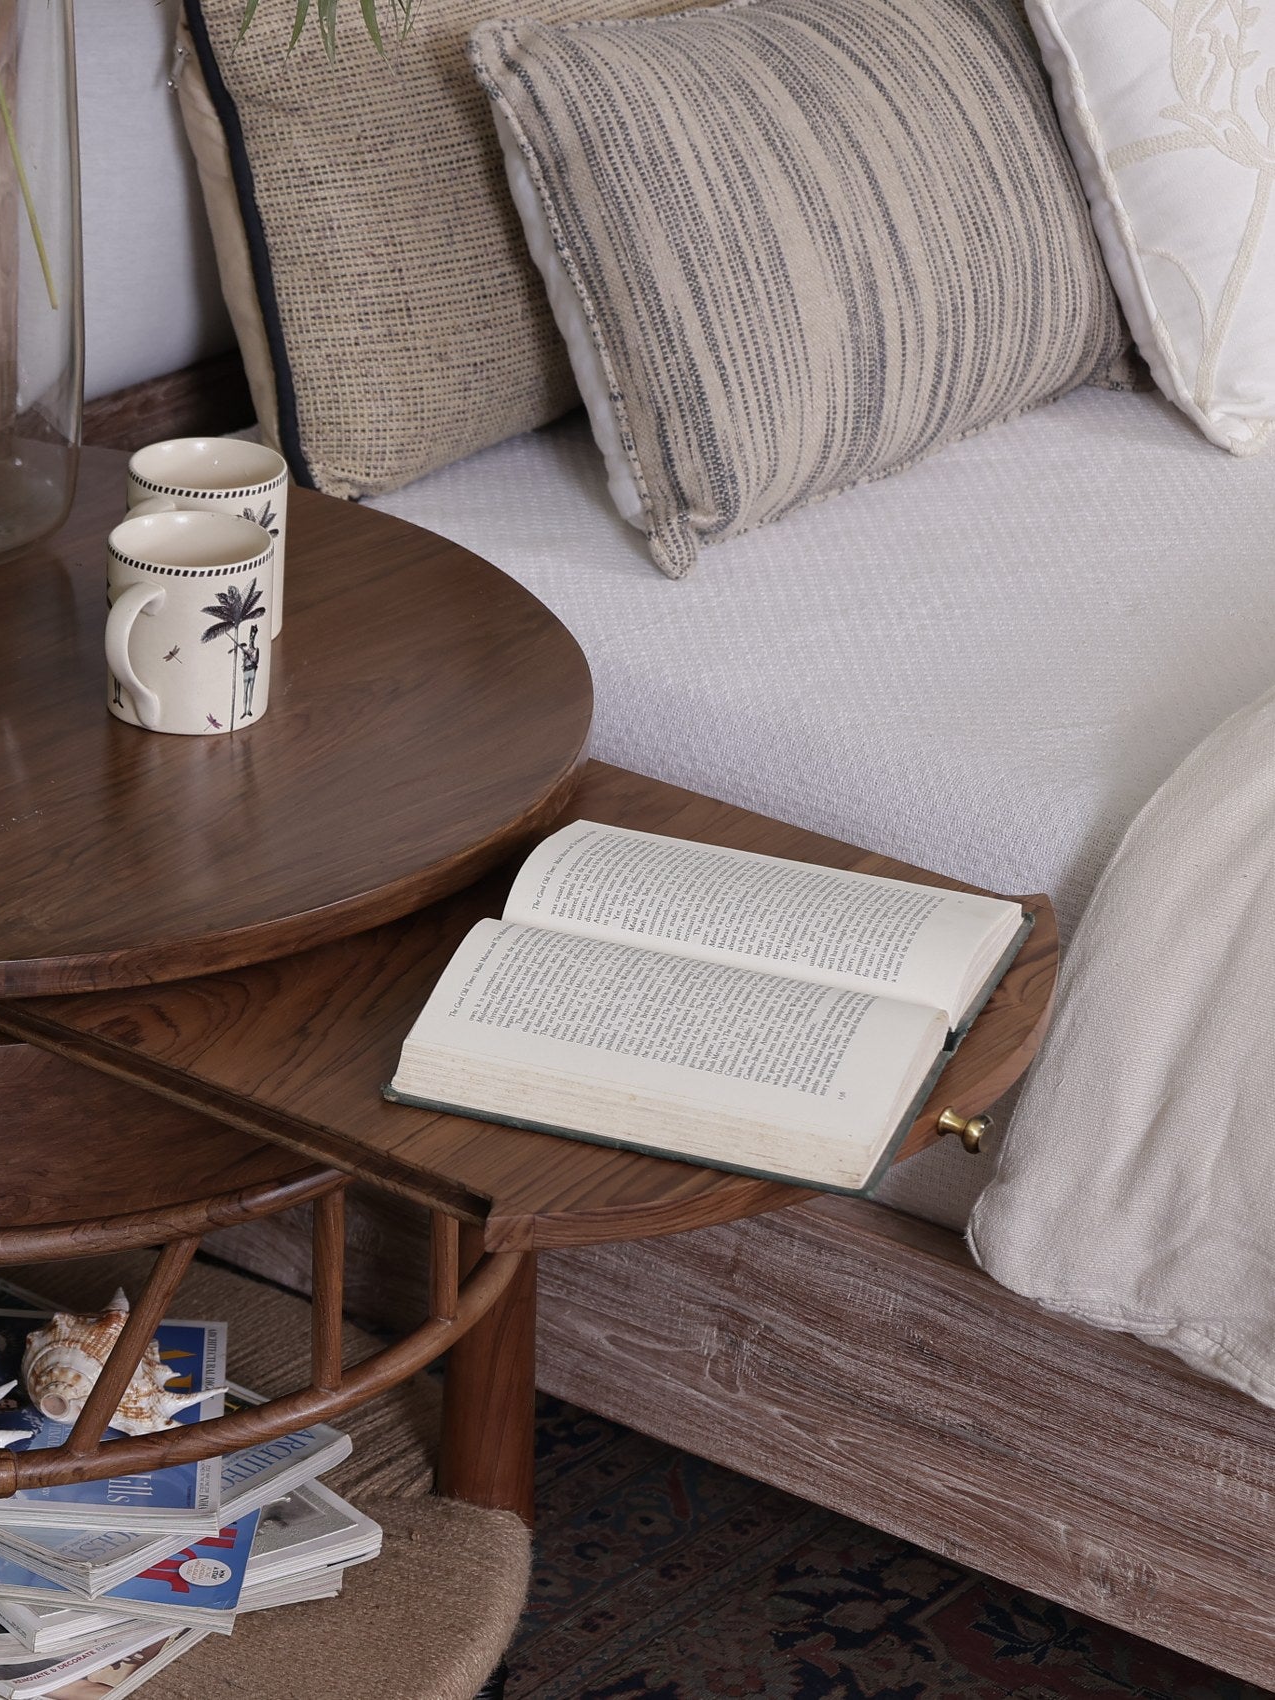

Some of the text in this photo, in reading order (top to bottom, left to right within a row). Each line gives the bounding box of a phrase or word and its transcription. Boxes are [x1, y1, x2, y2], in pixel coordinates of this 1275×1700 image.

[482, 971, 498, 995] nevertheless
[496, 984, 511, 1005] fragments
[515, 988, 539, 1023] Though Peacock
[496, 1014, 505, 1026] could
[502, 1015, 514, 1028] began
[539, 1024, 550, 1035] They
[792, 1066, 805, 1084] Peacock
[206, 1328, 217, 1376] ARCHITECTURAL
[221, 1430, 316, 1493] ARCHITEC
[198, 1494, 209, 1510] INDIA
[12, 1670, 51, 1684] RENOVATE
[57, 1650, 97, 1670] DECORATE
